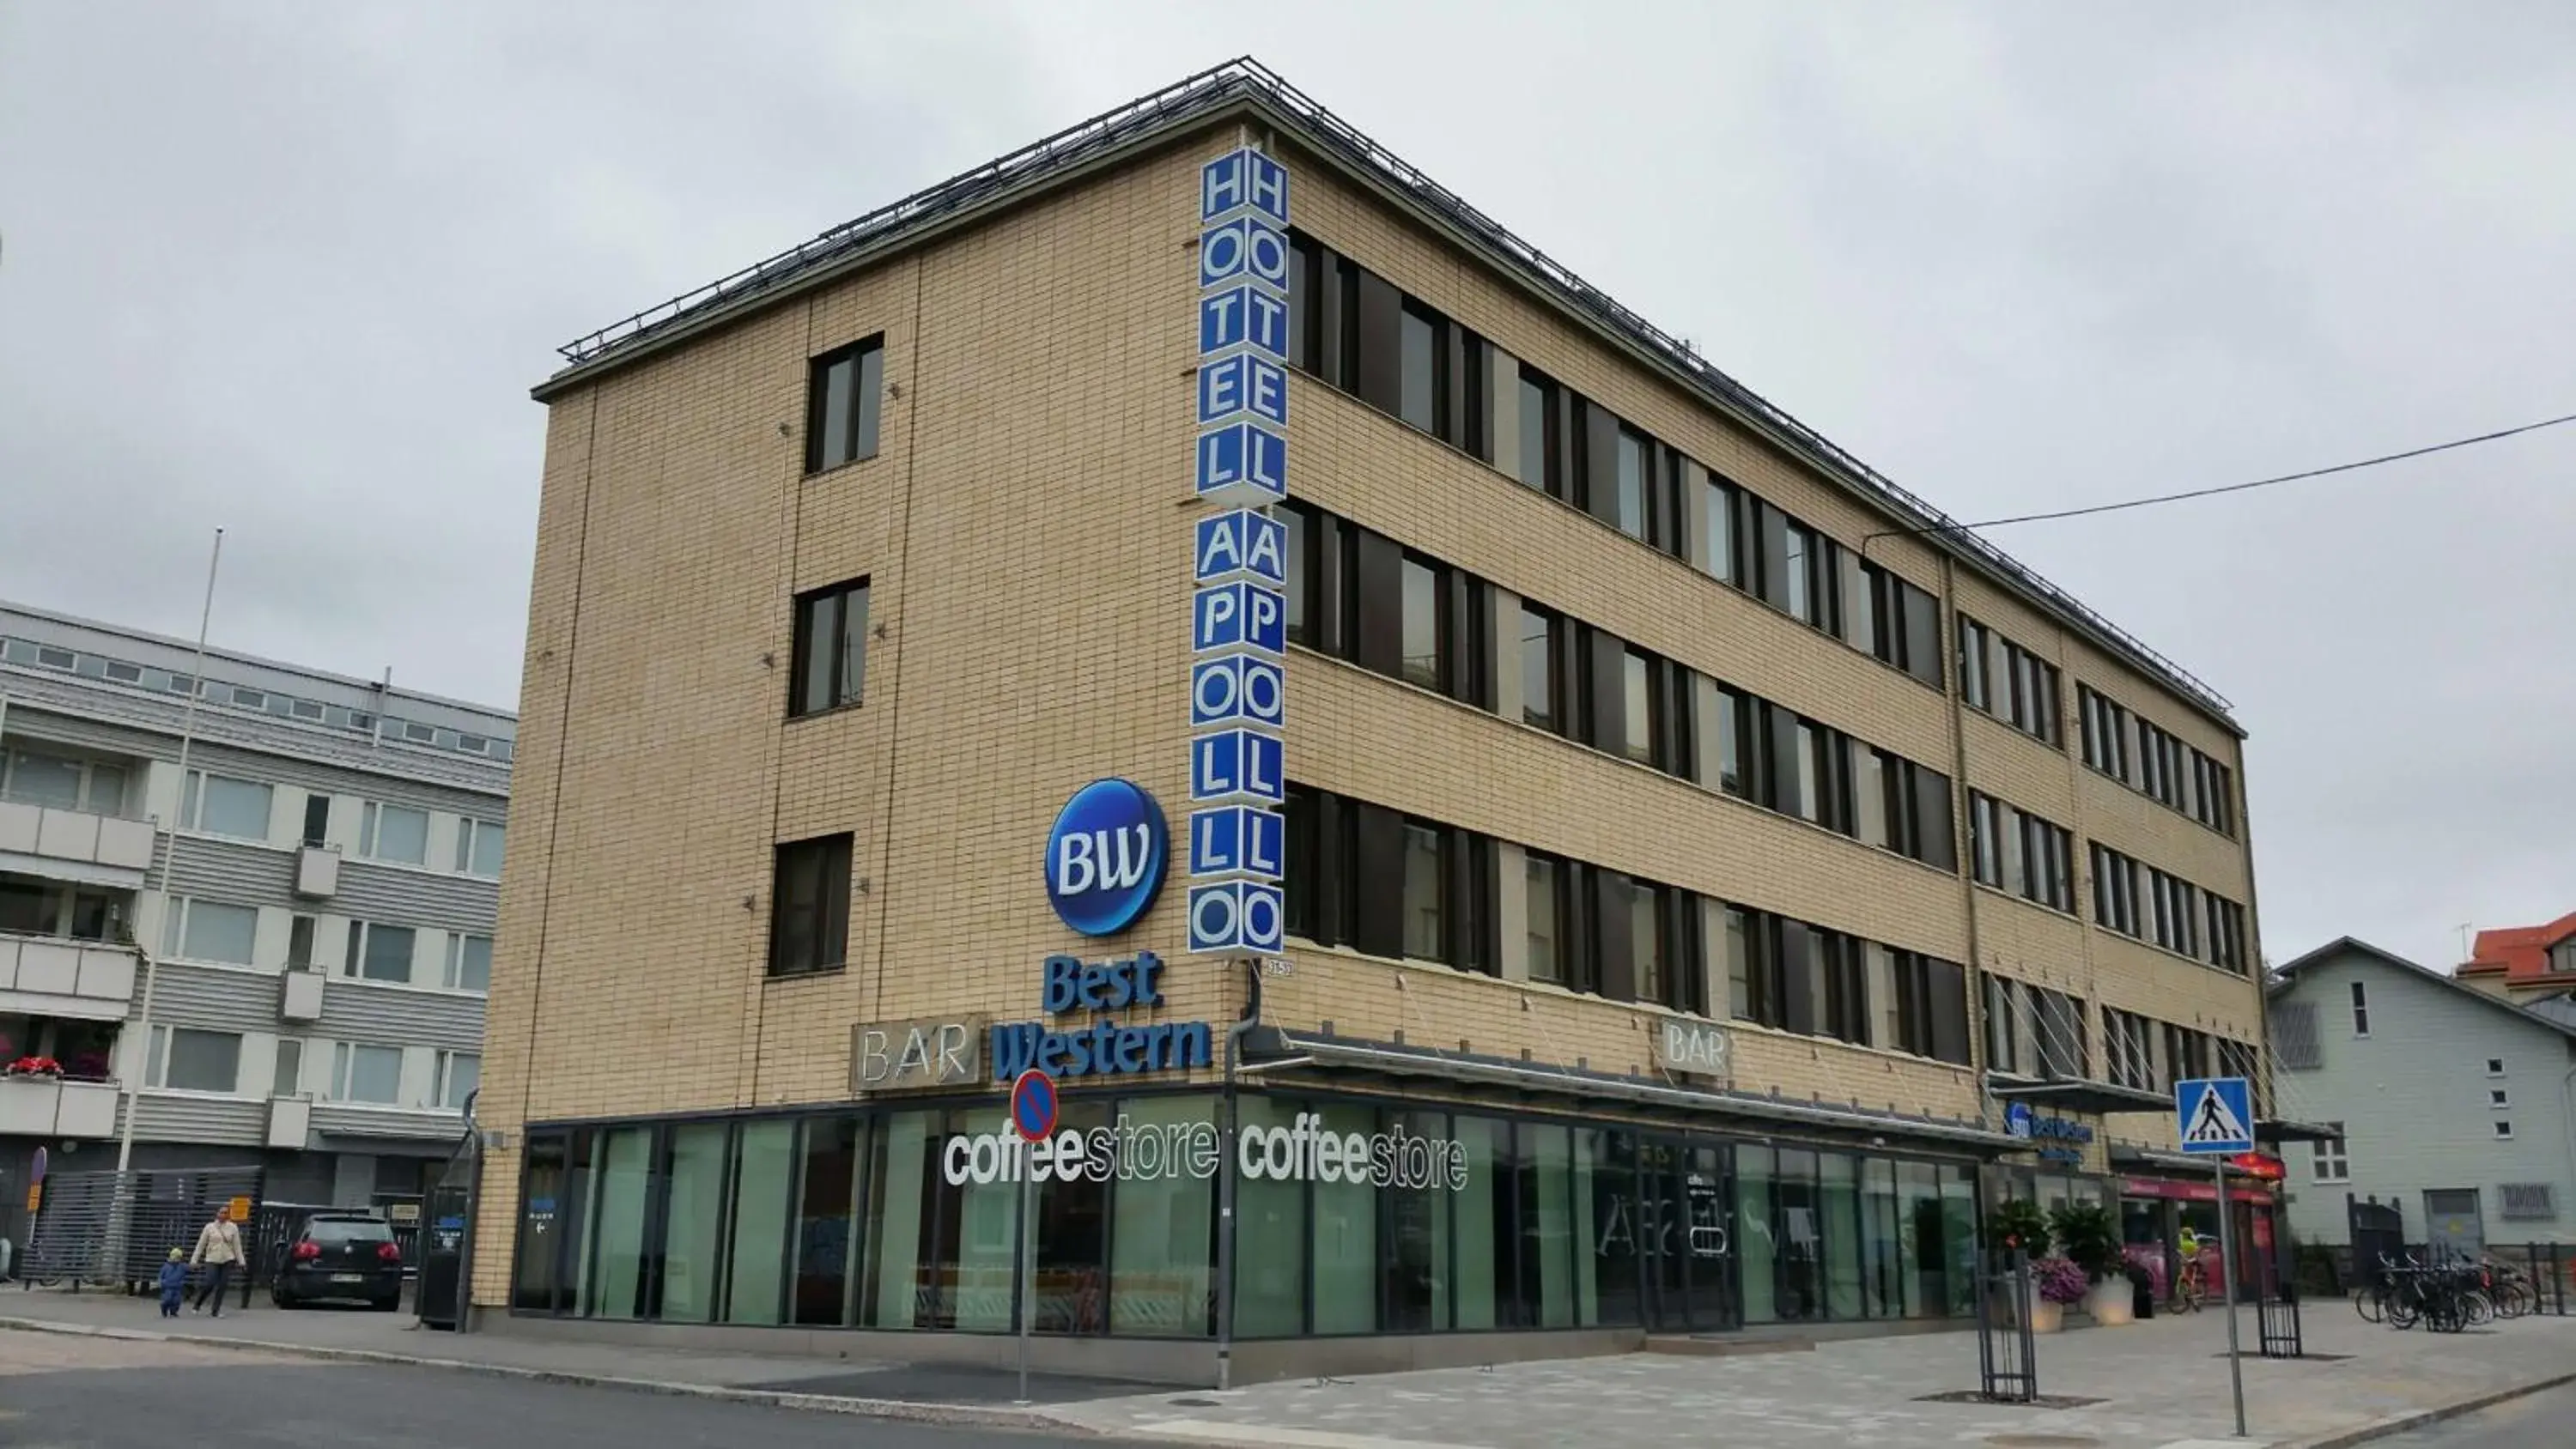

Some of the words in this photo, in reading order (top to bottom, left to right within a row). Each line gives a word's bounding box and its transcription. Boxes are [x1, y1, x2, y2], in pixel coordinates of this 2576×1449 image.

[1203, 158, 1245, 485] HOTEL
[1249, 156, 1286, 488] HOTEL
[1191, 521, 1241, 944] APOLLO
[1244, 524, 1283, 945] APOLLO
[1058, 823, 1151, 896] BW
[1043, 949, 1164, 1014] Best
[861, 1023, 970, 1083] BAR
[990, 1017, 1212, 1082] Western
[1668, 1024, 1726, 1070] BAR
[945, 1113, 1220, 1185] coffeestore
[1238, 1112, 1469, 1191] coffeestore
